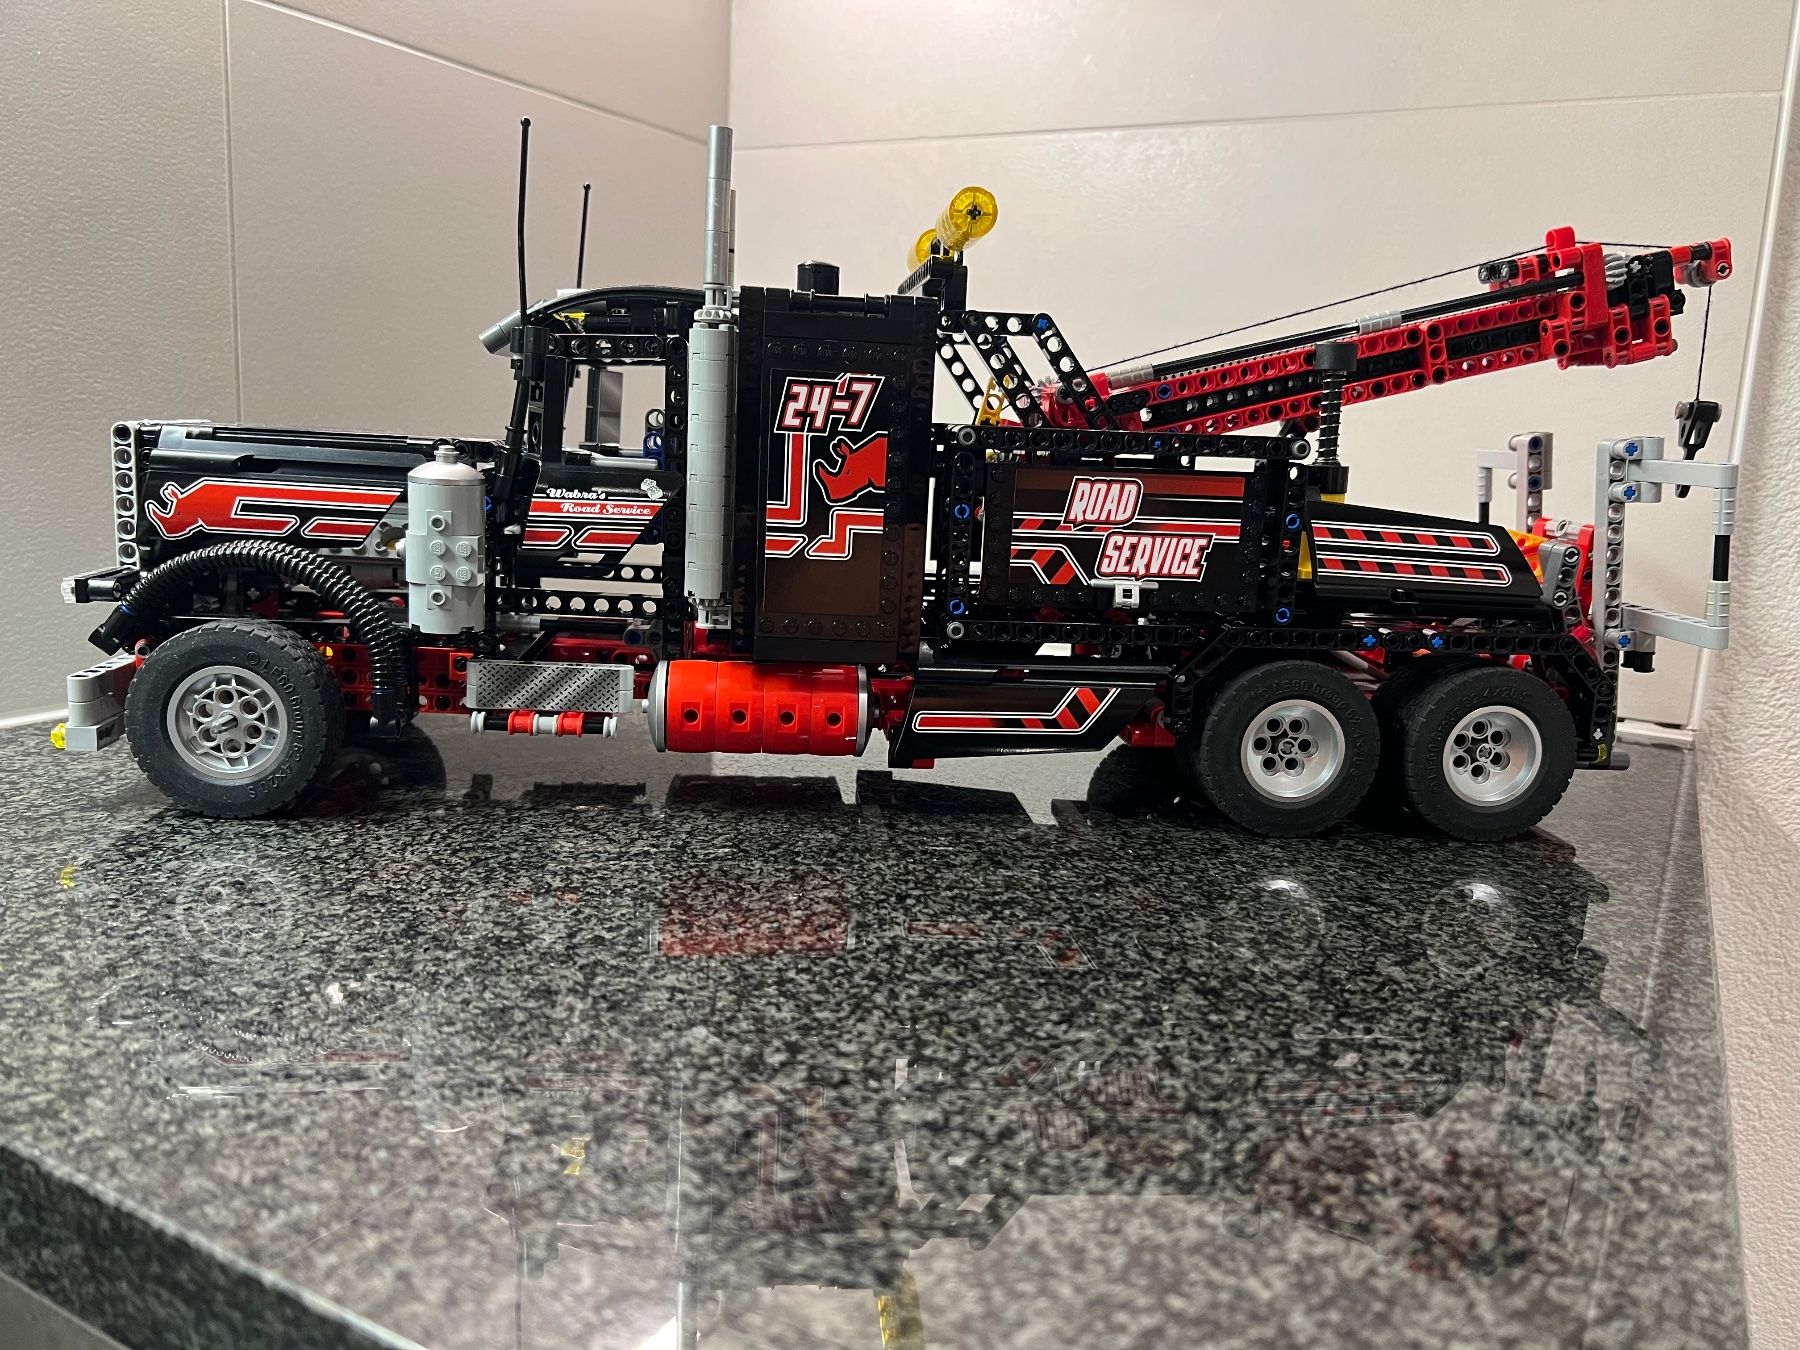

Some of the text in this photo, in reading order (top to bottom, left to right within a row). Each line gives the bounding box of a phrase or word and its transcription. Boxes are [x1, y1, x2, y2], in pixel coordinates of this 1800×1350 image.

[781, 380, 877, 430] 24-7
[546, 487, 606, 500] Wabra's
[560, 502, 652, 516] Road Service
[1067, 481, 1140, 523] ROAD
[1100, 534, 1209, 577] SERVICE
